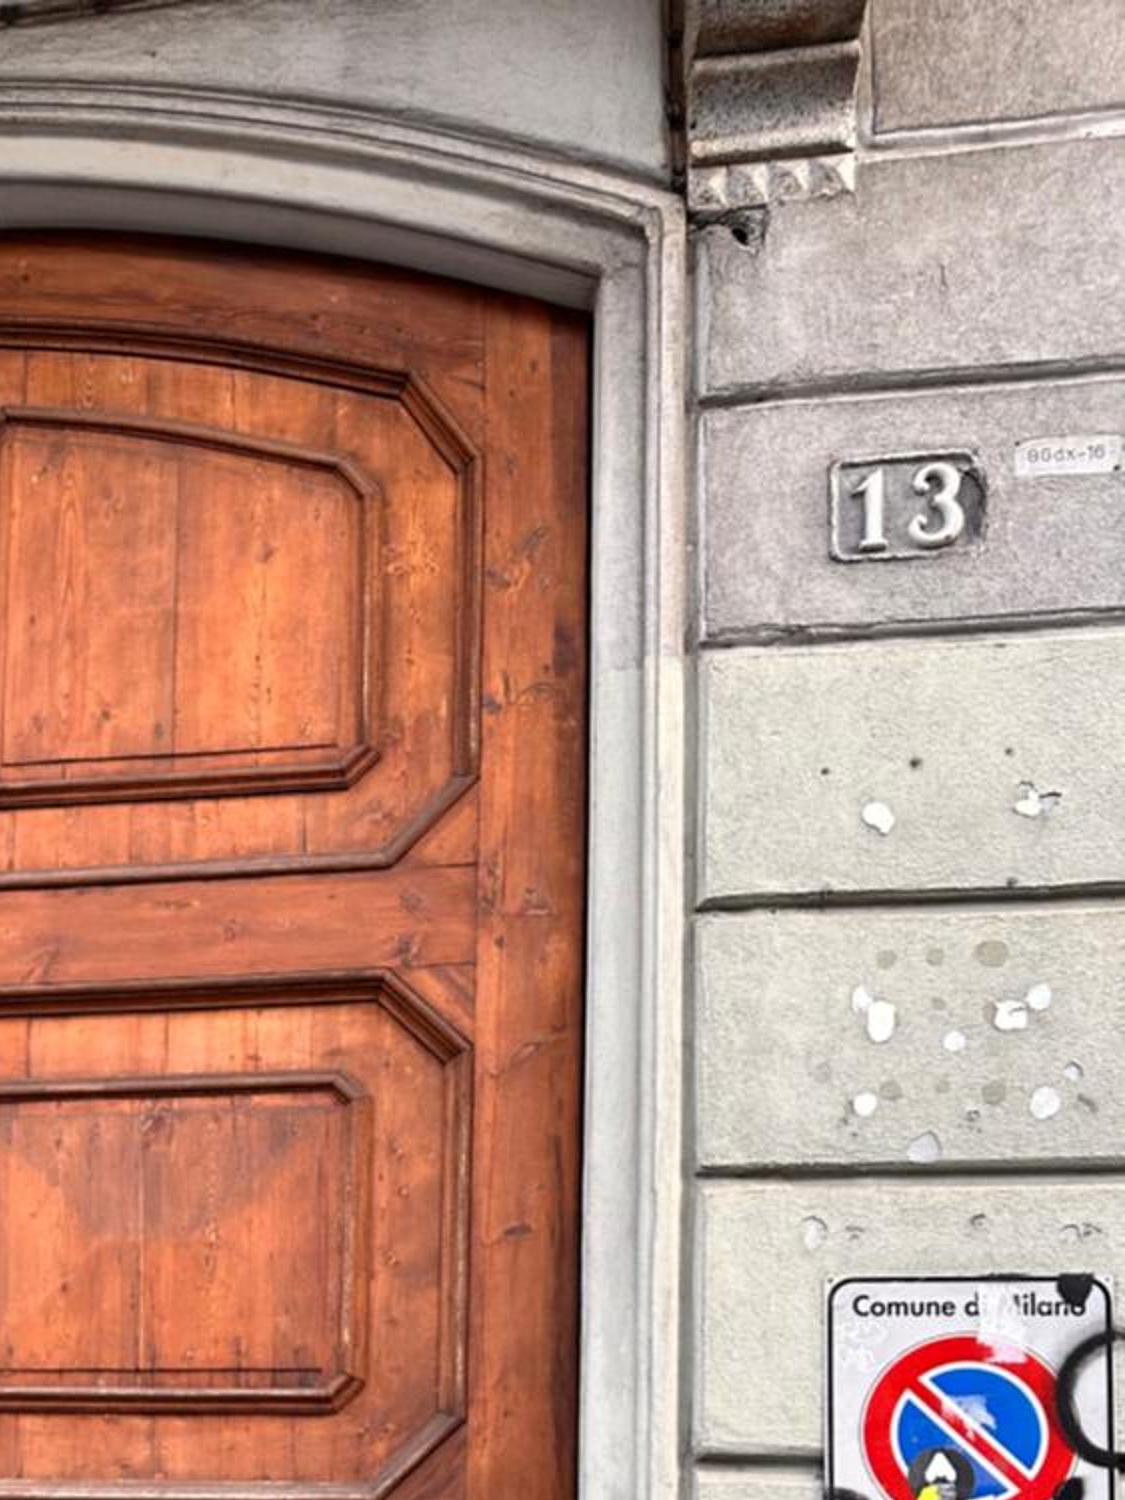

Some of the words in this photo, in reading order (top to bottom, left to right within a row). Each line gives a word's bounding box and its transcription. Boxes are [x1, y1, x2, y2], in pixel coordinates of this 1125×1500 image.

[850, 462, 965, 551] 13
[852, 1294, 956, 1317] Comune
[964, 1291, 980, 1317] d
[1014, 1291, 1086, 1317] ilano
